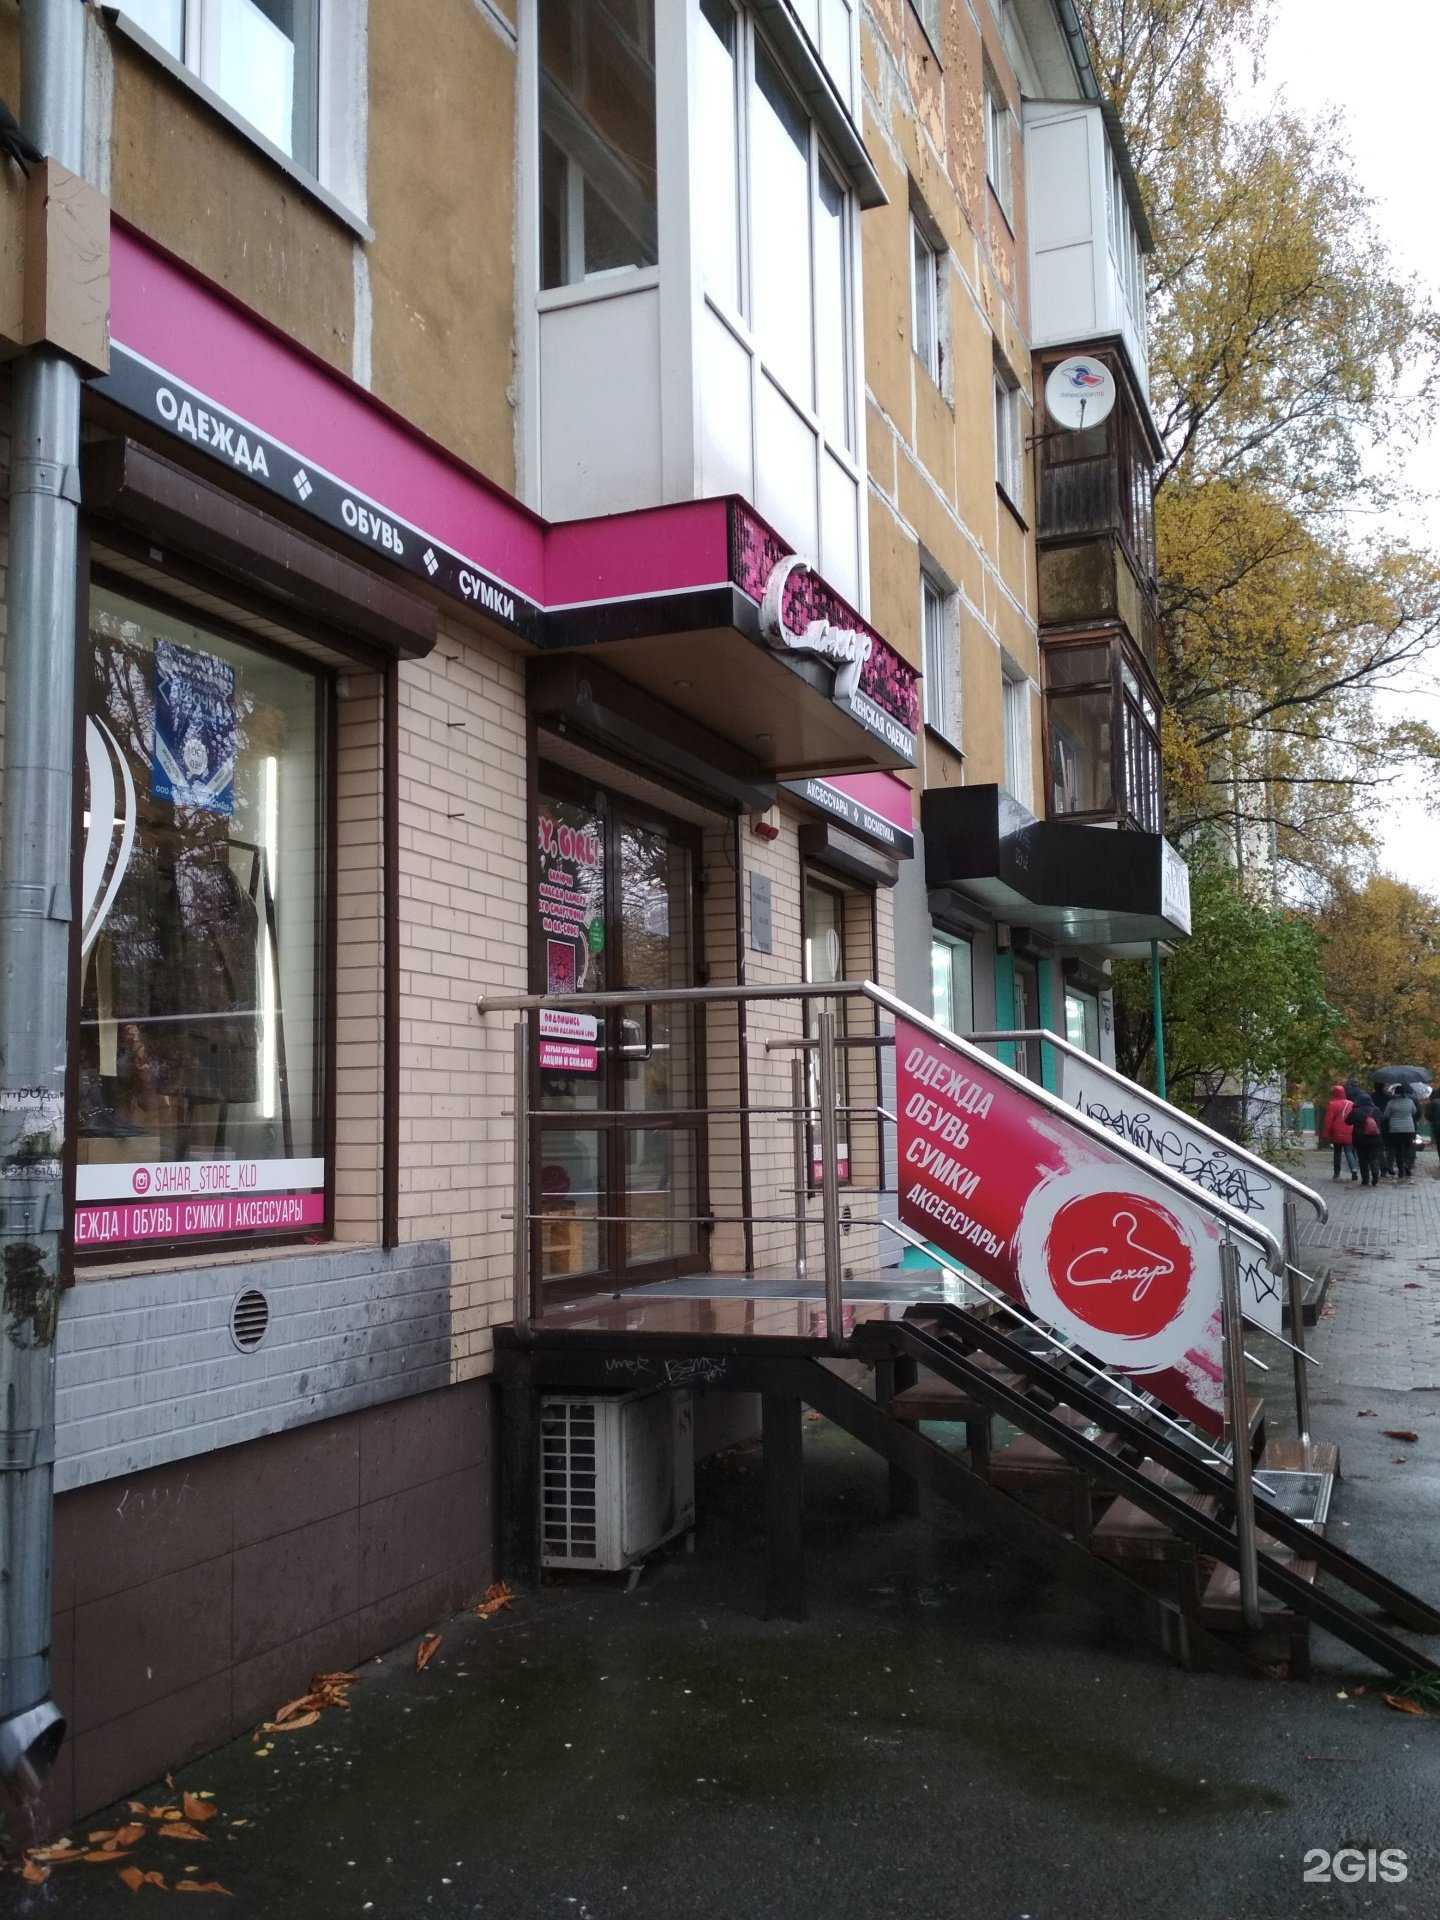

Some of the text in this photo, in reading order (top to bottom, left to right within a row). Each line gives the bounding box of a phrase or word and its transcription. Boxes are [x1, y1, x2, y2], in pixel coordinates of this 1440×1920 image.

[155, 387, 515, 622] ОДЕЖДА ОБУВЬ СУМКИ
[886, 722, 913, 757] ОДЕЖДА
[806, 781, 895, 843] АКСЕССУАРЫ КОСМЕТИКА
[904, 1047, 995, 1121] ОДЕЖДА
[904, 1092, 970, 1151] ОБУВЬ
[155, 1164, 257, 1193] SAHAR_STORE_KLD
[905, 1137, 981, 1200] СУМКИ
[133, 1208, 172, 1236] ОБУВЬ
[185, 1203, 224, 1231] СУМКИ
[235, 1199, 304, 1227] АКСЕССУАРЫ
[905, 1182, 1006, 1260] АКСЕССУАРЫ
[1067, 1246, 1174, 1302] Сахар
